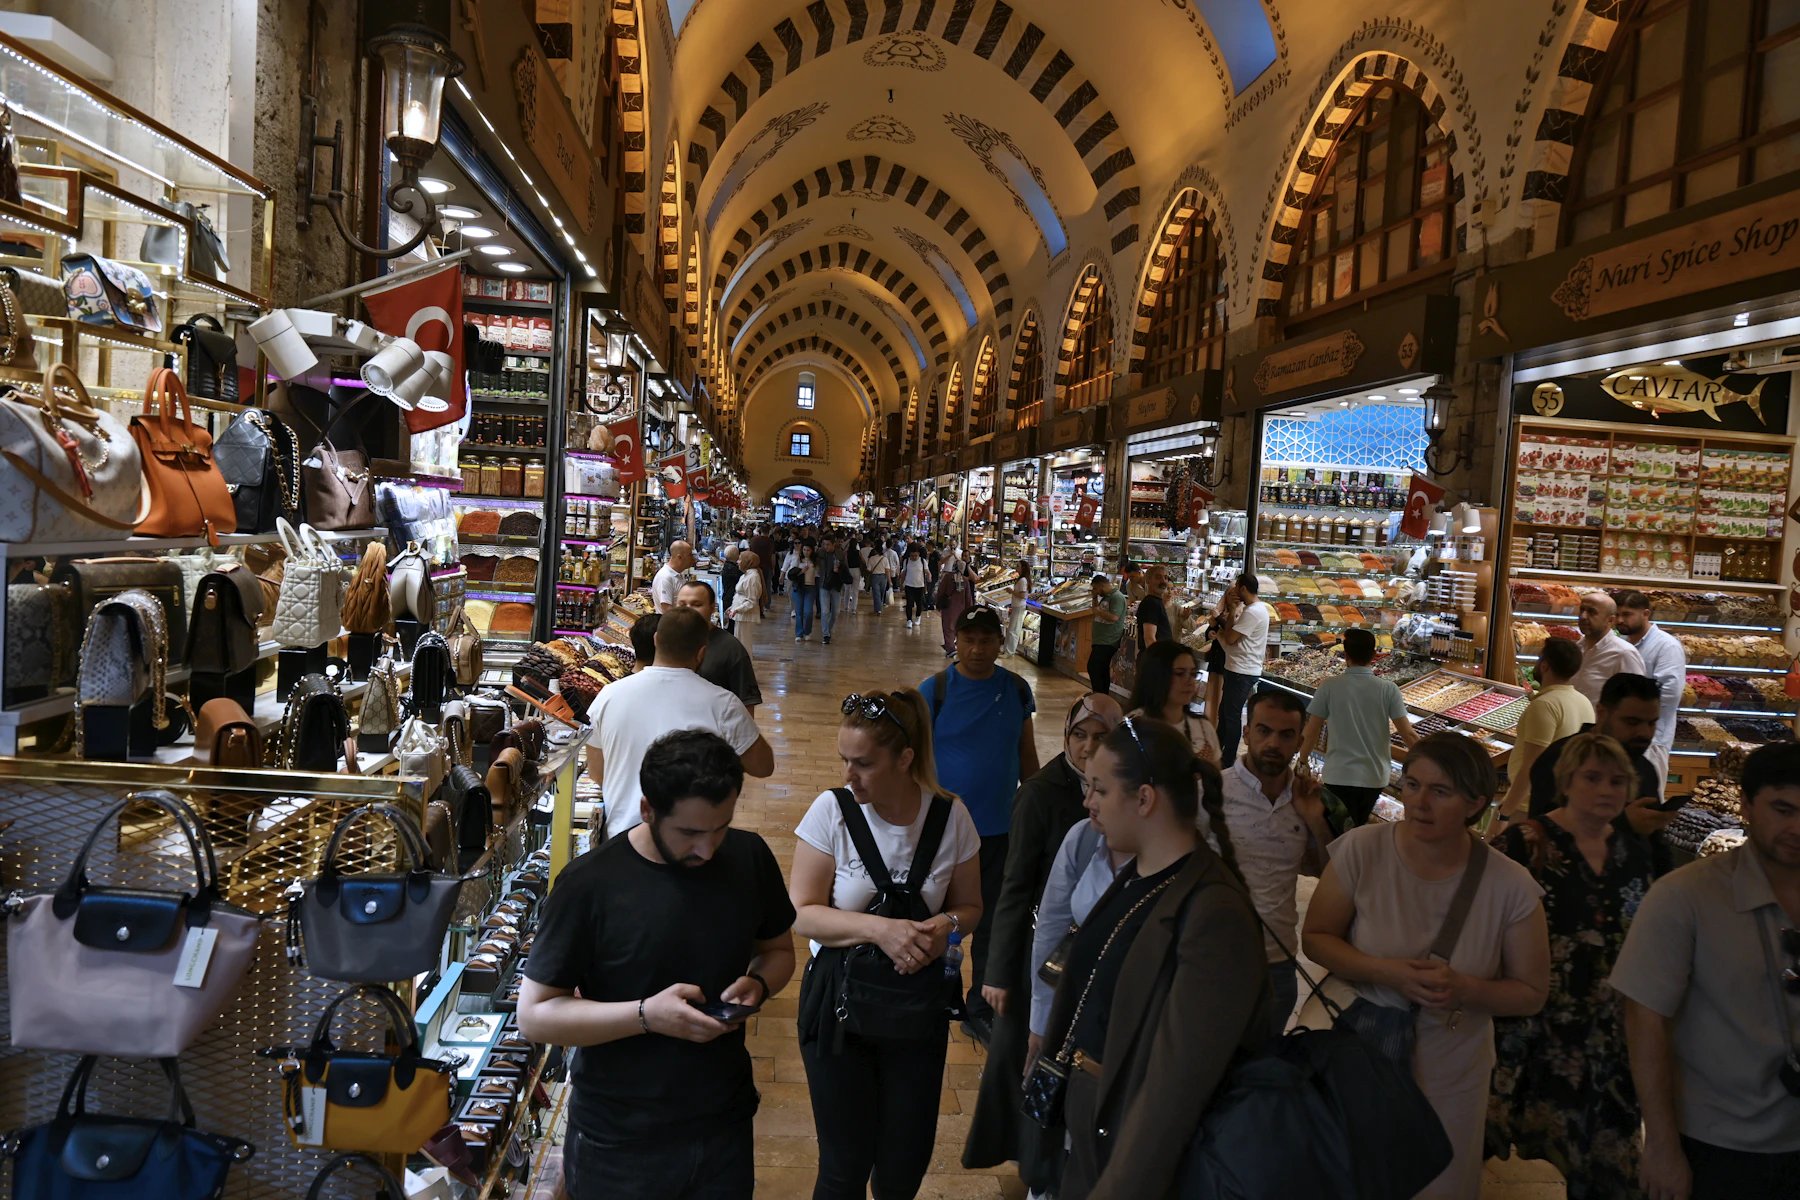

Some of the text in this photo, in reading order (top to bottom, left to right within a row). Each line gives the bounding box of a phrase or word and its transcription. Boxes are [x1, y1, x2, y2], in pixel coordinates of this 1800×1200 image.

[1595, 217, 1800, 292] Nuri Spice Shop
[1401, 342, 1413, 360] 53
[1269, 358, 1307, 380] Ramazan
[1536, 390, 1561, 411] 55
[1611, 374, 1722, 403] CAVIAR
[184, 937, 203, 981] LONGCHAMP
